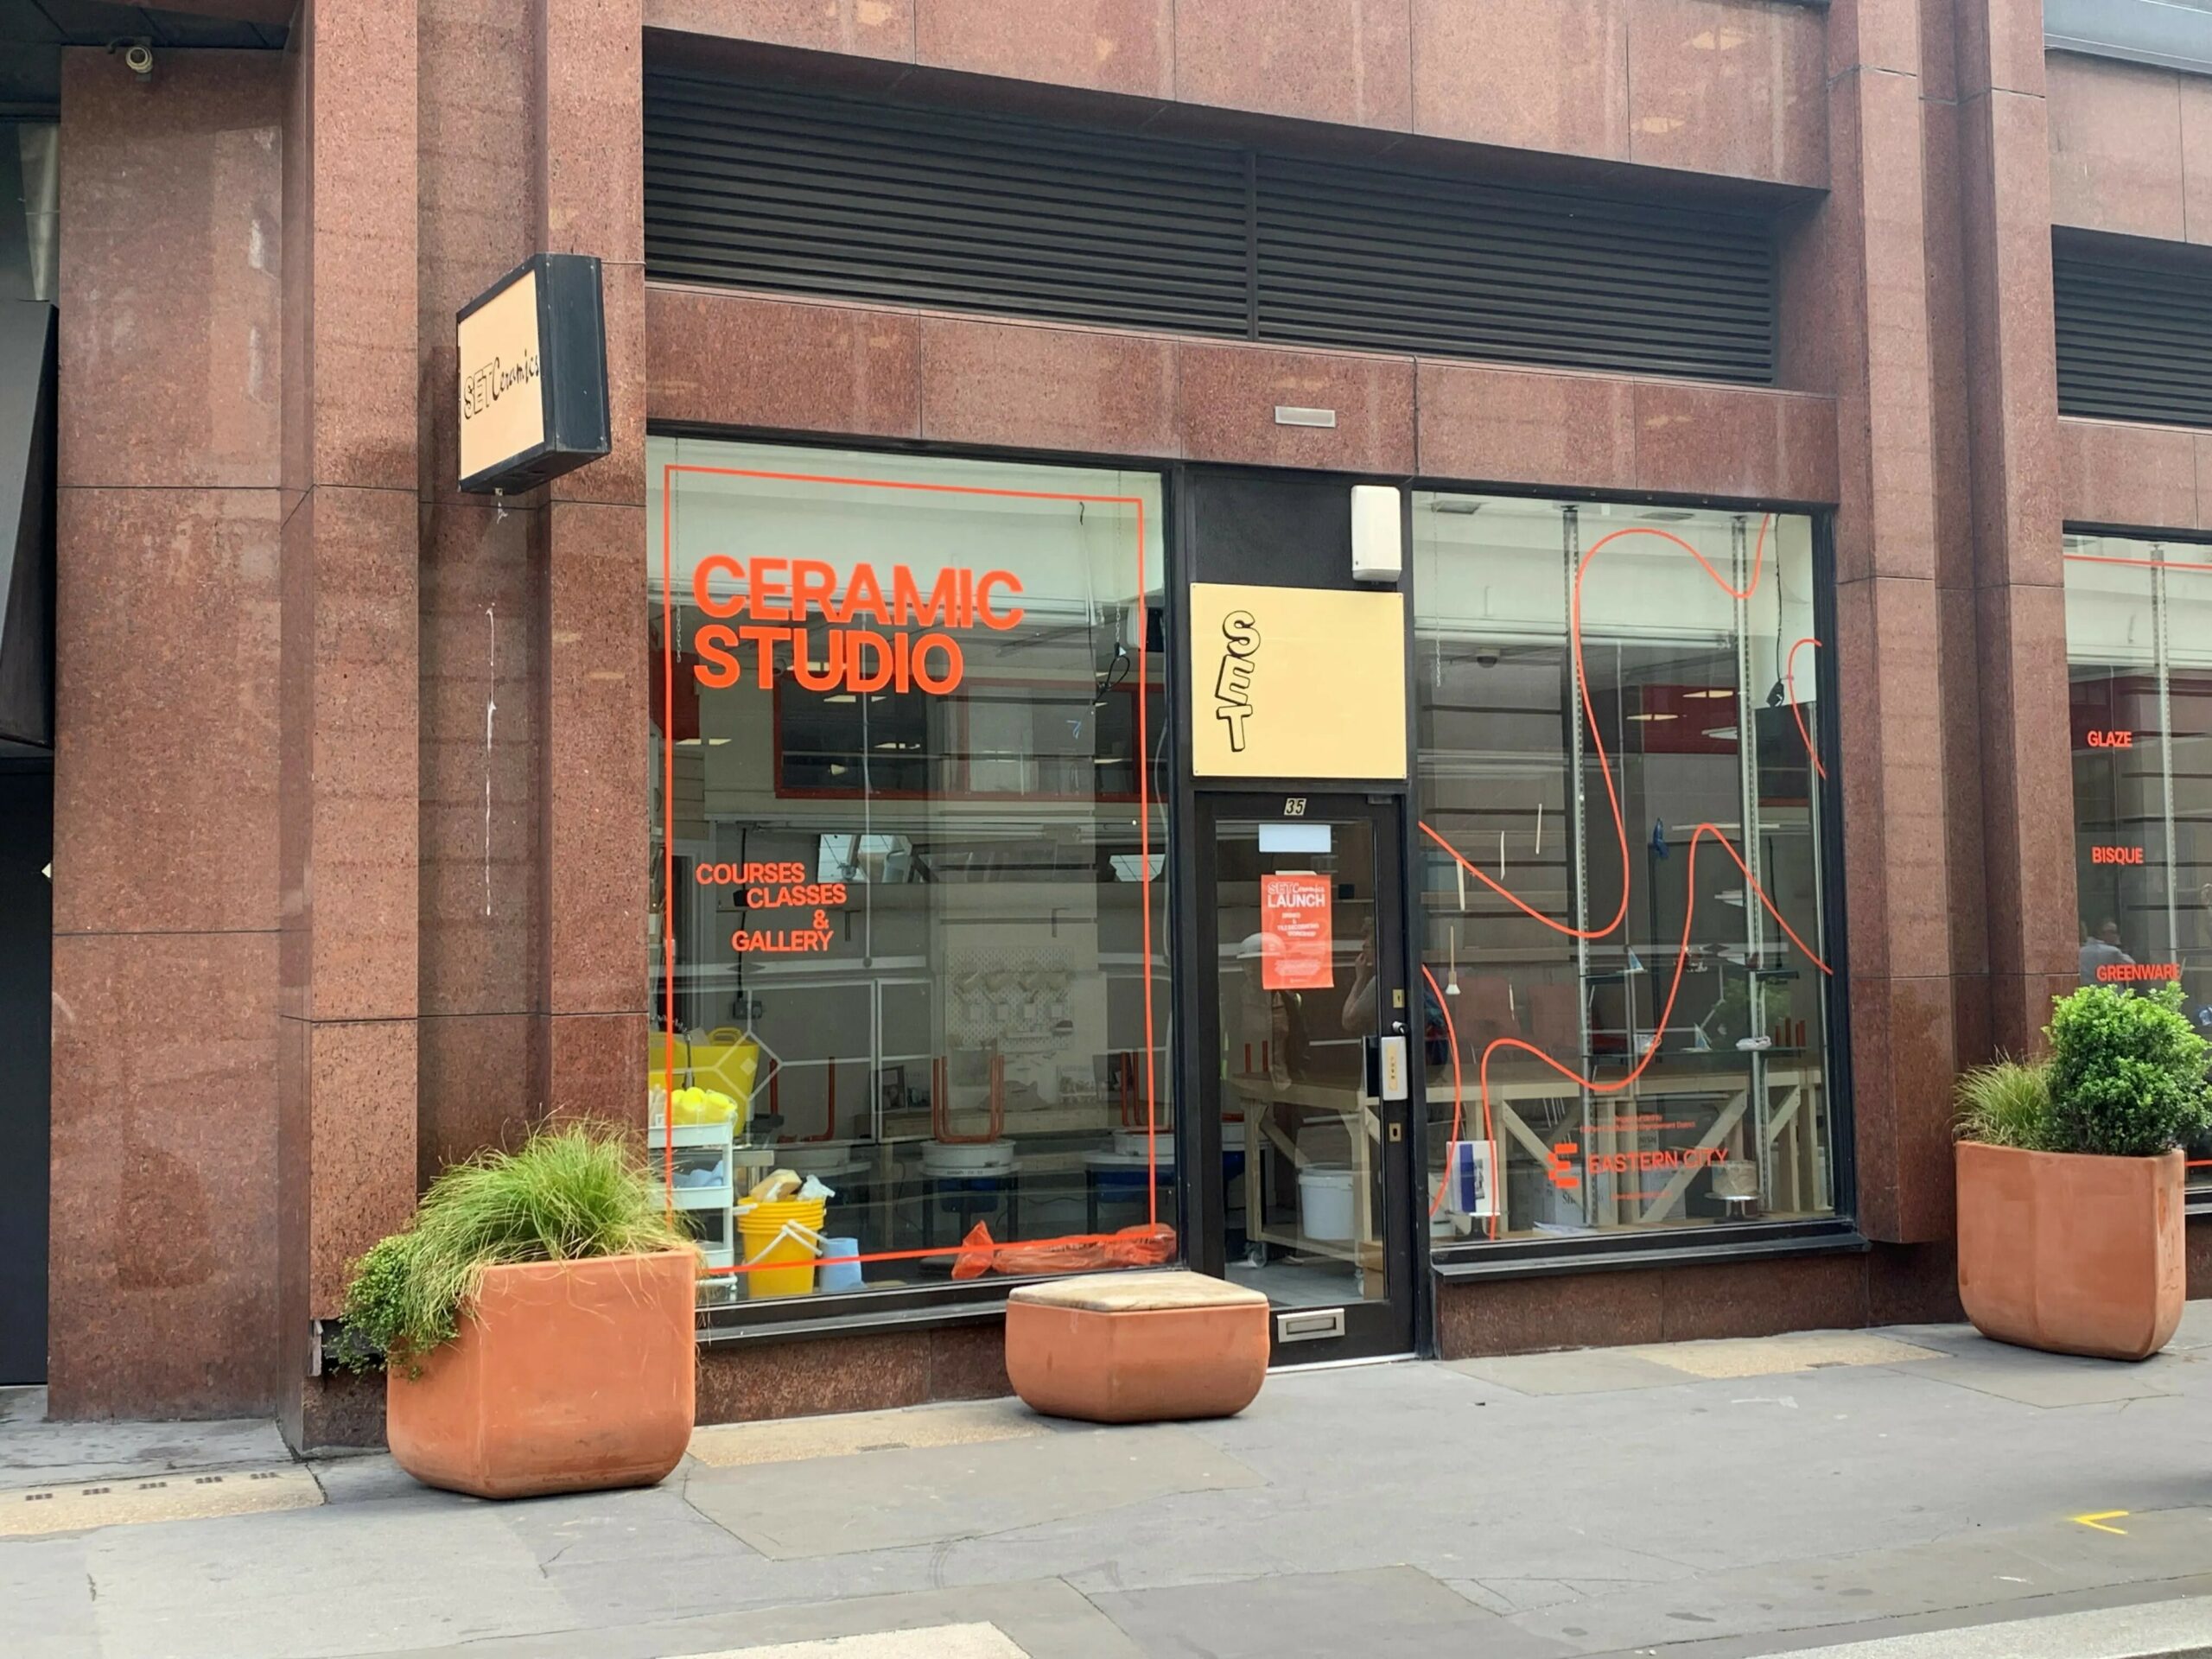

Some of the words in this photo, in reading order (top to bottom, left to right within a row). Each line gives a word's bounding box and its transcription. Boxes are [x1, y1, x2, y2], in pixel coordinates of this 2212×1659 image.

[693, 554, 1024, 630] CERAMIC
[693, 625, 963, 695] STUDIO
[1215, 610, 1262, 753] SET
[2087, 730, 2133, 747] GLAZE
[1286, 798, 1306, 815] 35
[2091, 846, 2144, 865] BISQUE
[696, 862, 805, 885] COURSES
[747, 884, 848, 909] CLASSES
[1267, 893, 1326, 908] LAUNCH
[812, 909, 830, 930] &
[732, 931, 834, 951] GALLERY
[2095, 963, 2181, 982] GREENWARE
[1588, 1150, 1678, 1174] EASTERN
[1683, 1147, 1728, 1169] CITY
